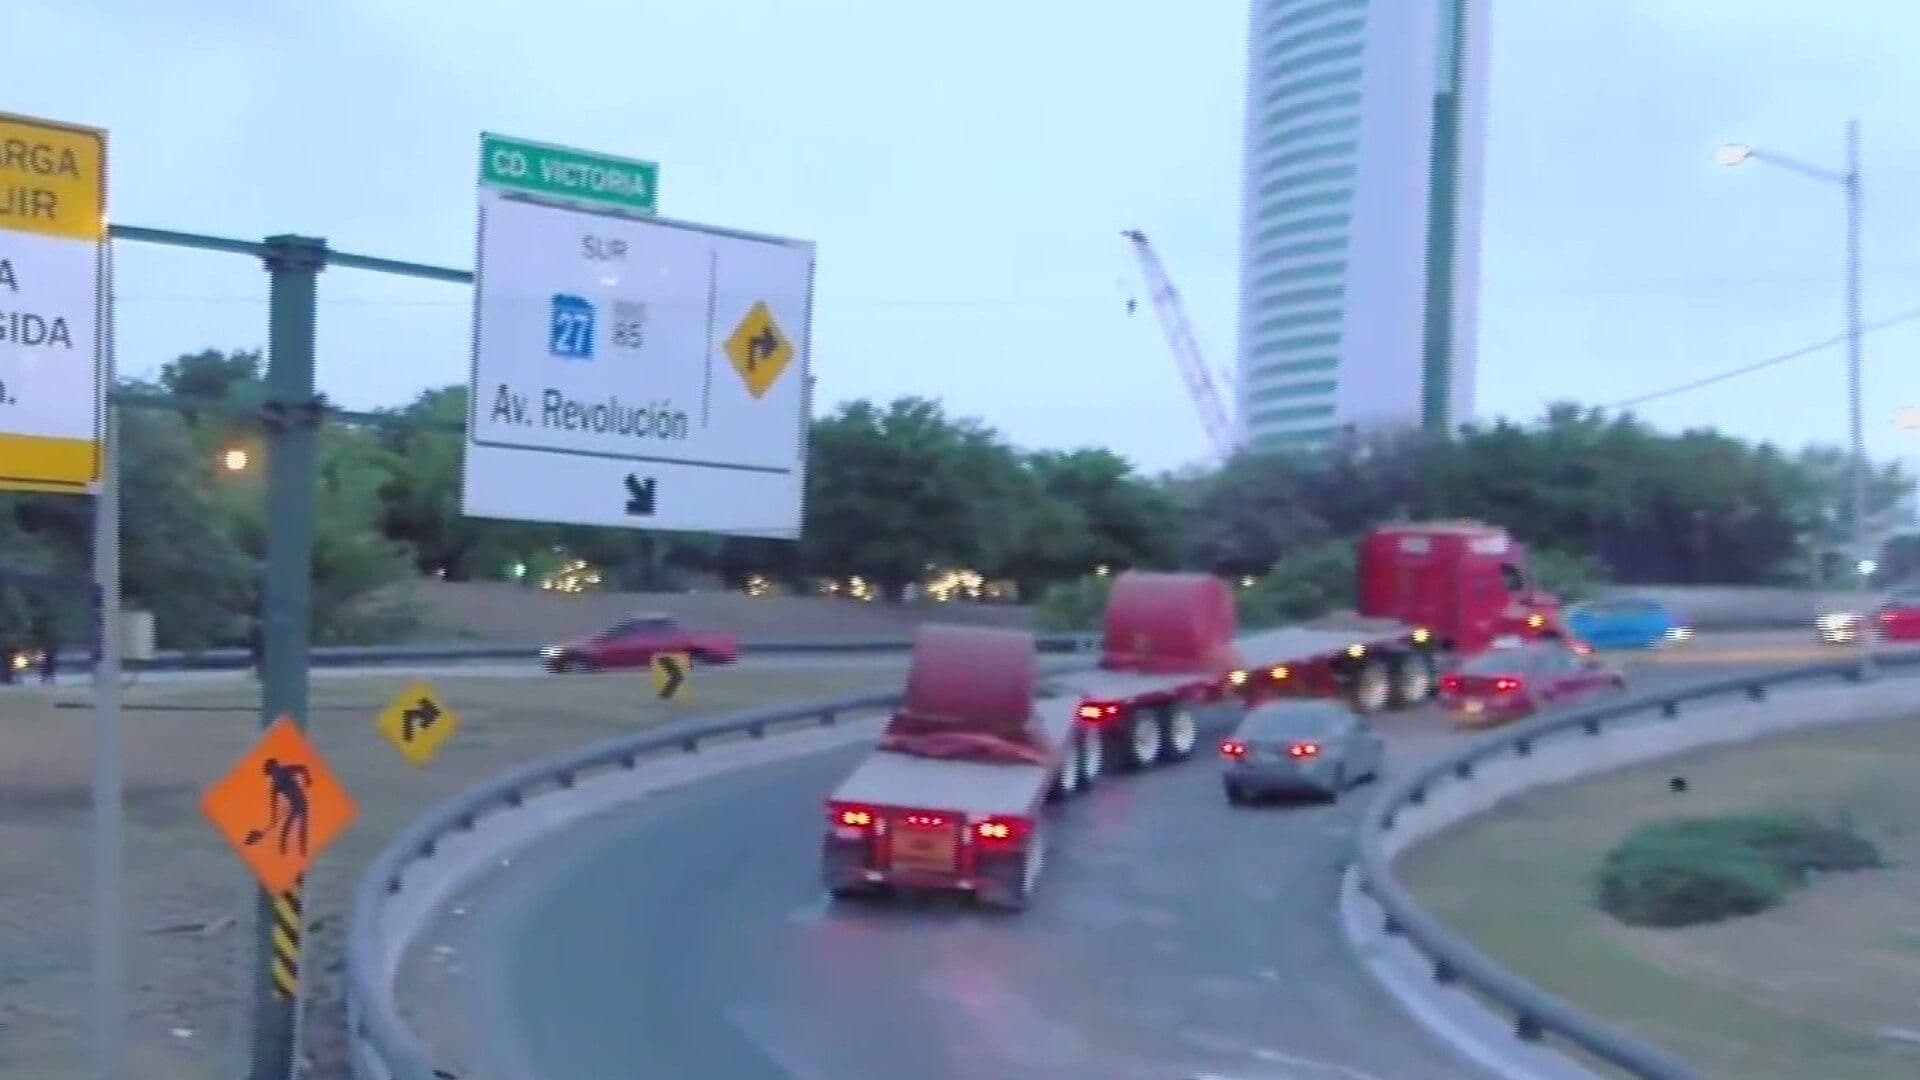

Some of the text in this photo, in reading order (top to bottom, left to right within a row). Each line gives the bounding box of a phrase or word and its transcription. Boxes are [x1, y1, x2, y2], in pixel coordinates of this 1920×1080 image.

[0, 137, 80, 180] RGA
[540, 156, 647, 197] VICTORIA
[581, 234, 628, 261] SUR
[555, 311, 589, 353] 27
[611, 321, 645, 349] 85
[491, 383, 689, 441] Av. Revolución
